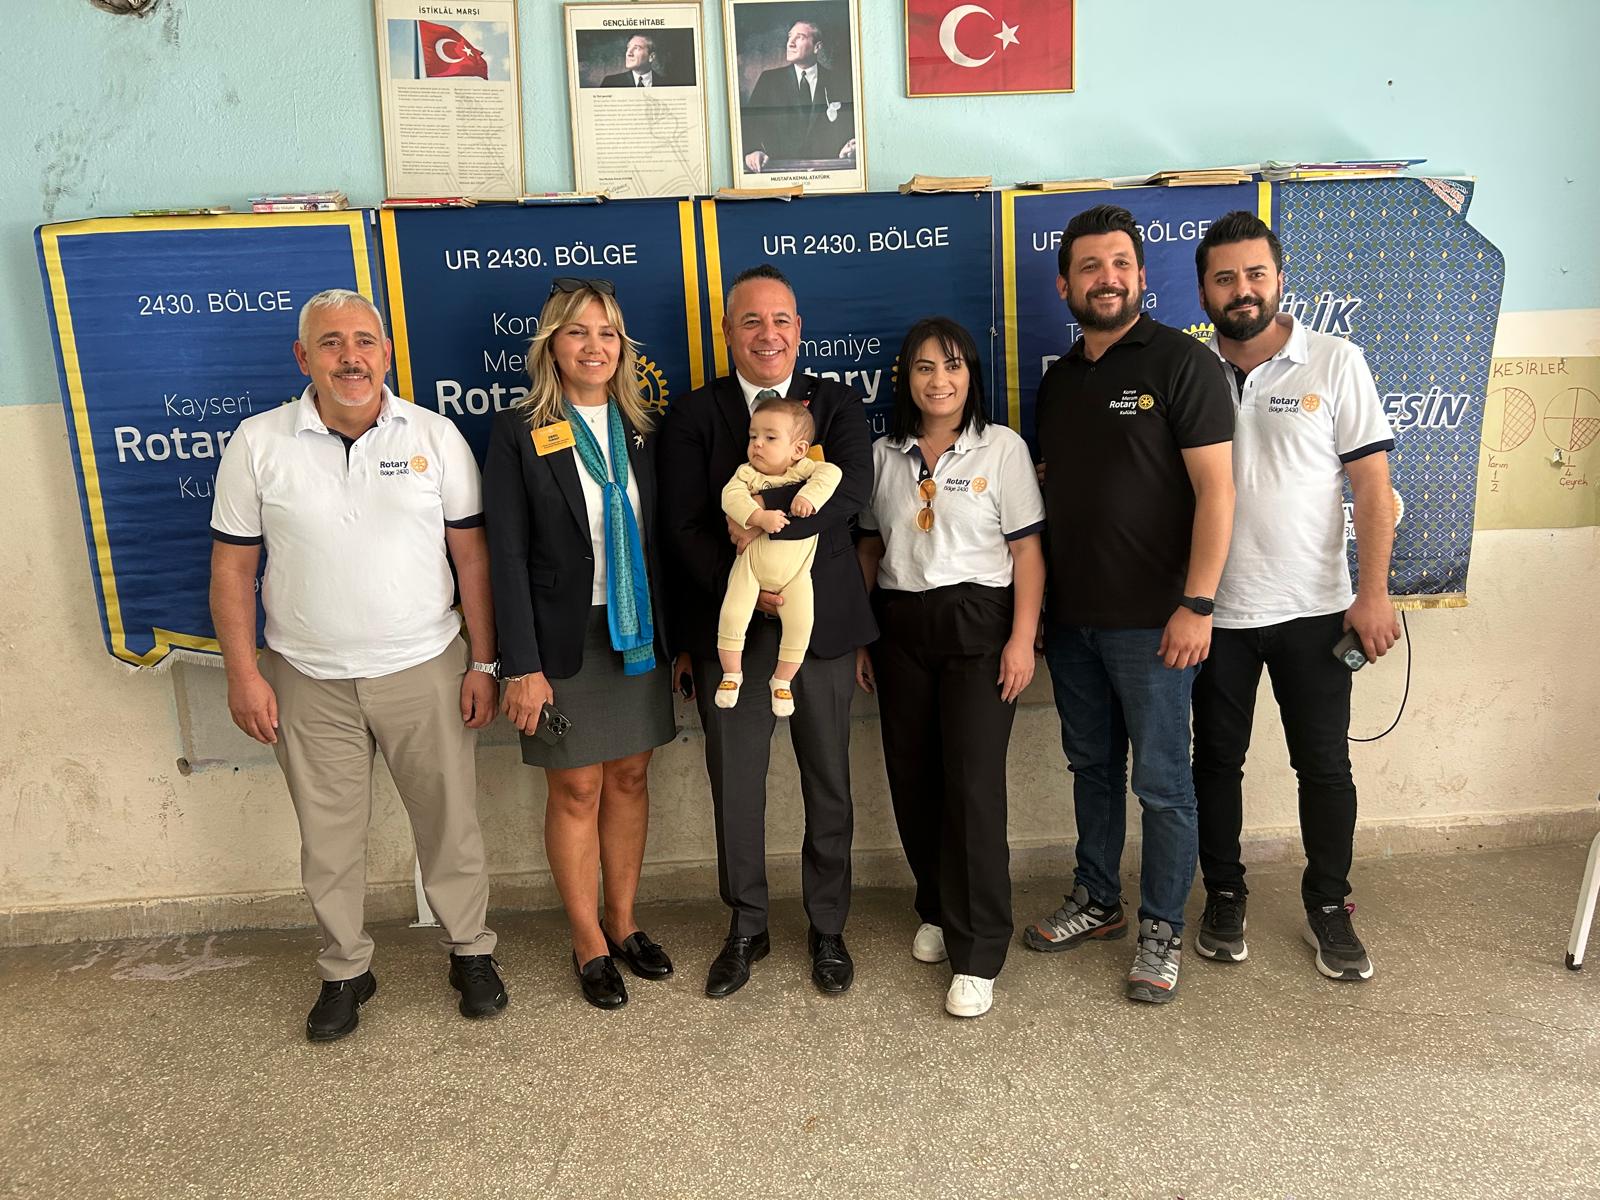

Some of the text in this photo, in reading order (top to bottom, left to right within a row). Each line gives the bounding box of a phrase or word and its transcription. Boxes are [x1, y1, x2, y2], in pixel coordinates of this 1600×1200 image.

[419, 6, 453, 15] İSTİKLÂL
[602, 17, 665, 27] GENÇLİĞE HİTABE
[763, 226, 949, 256] UR 2430. BÖLGE
[445, 241, 638, 270] UR 2430. BÖLGE
[138, 289, 293, 316] 2430. BÖLGE
[493, 313, 540, 336] Kon
[796, 333, 881, 362] maniye
[1493, 360, 1569, 378] KESİRLER
[164, 391, 252, 422] Kayseri
[436, 380, 530, 416] Rota
[1109, 401, 1137, 409] Rotary
[1270, 396, 1300, 407] Rotary
[1383, 388, 1469, 430] EŞİN
[114, 426, 236, 463] Rotar
[380, 461, 408, 469] Rotary
[178, 474, 216, 499] Kul
[946, 478, 971, 486] Rotary
